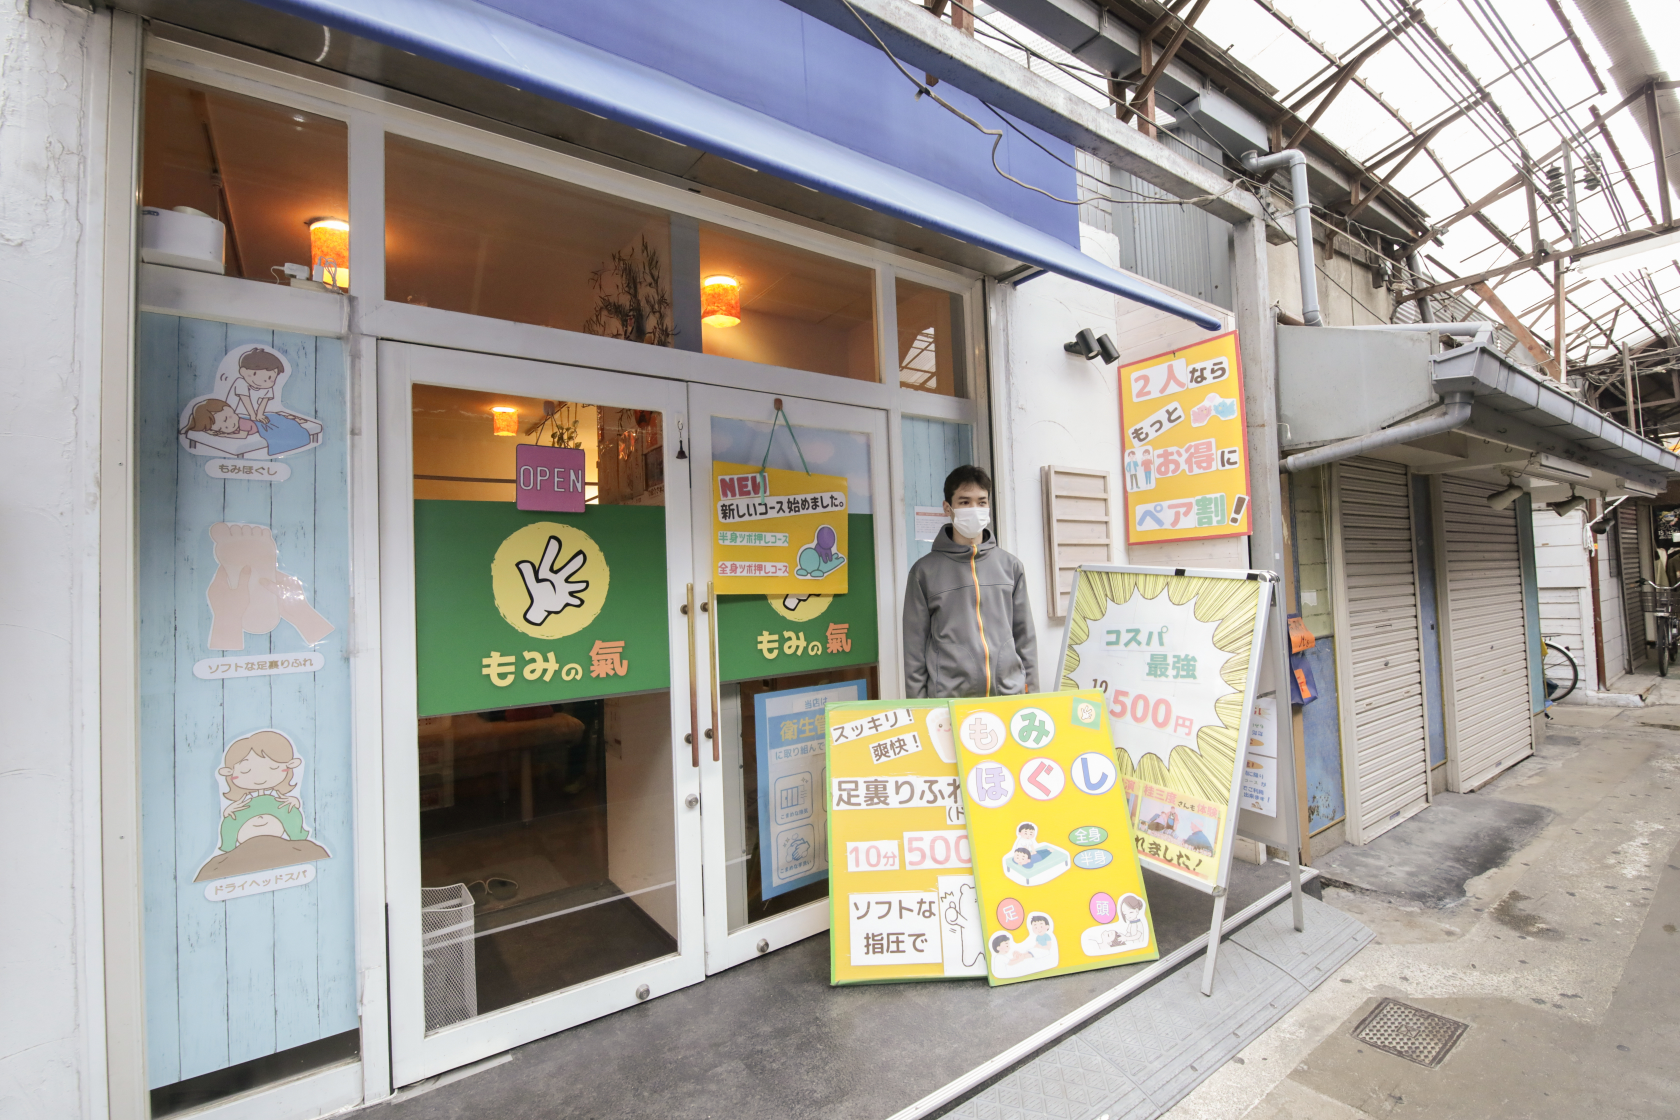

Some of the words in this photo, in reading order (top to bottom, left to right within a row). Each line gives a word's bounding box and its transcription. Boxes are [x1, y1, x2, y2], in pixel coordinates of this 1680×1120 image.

[1134, 361, 1227, 399] 2人なら
[1131, 406, 1182, 443] もっと
[218, 463, 278, 476] もみほぐし
[1156, 440, 1238, 477] お得に
[519, 465, 583, 493] OPEN
[719, 475, 768, 499] NEW
[718, 531, 789, 545] 半身ツボ押しコース
[718, 563, 789, 576] 全身ツボ押しコース
[757, 622, 851, 660] もみの氣
[1105, 625, 1169, 649] コスパ
[208, 658, 314, 674] ソフトな足裏りふれ
[482, 639, 628, 687] もみの氣
[1146, 653, 1198, 680] 最強
[833, 708, 914, 743] スッキリ！
[968, 711, 1050, 750] もみ
[871, 734, 920, 762] 爽快！
[975, 757, 1109, 802] ほぐし
[1074, 828, 1101, 844] 全身
[849, 845, 897, 869] 10分
[1080, 850, 1107, 866] 半身
[214, 869, 308, 896] ドライヘッドスパ
[853, 898, 937, 920] ソフトな
[1003, 905, 1019, 923] 足
[1096, 900, 1110, 917] 頭
[863, 932, 928, 956] 指圧で
